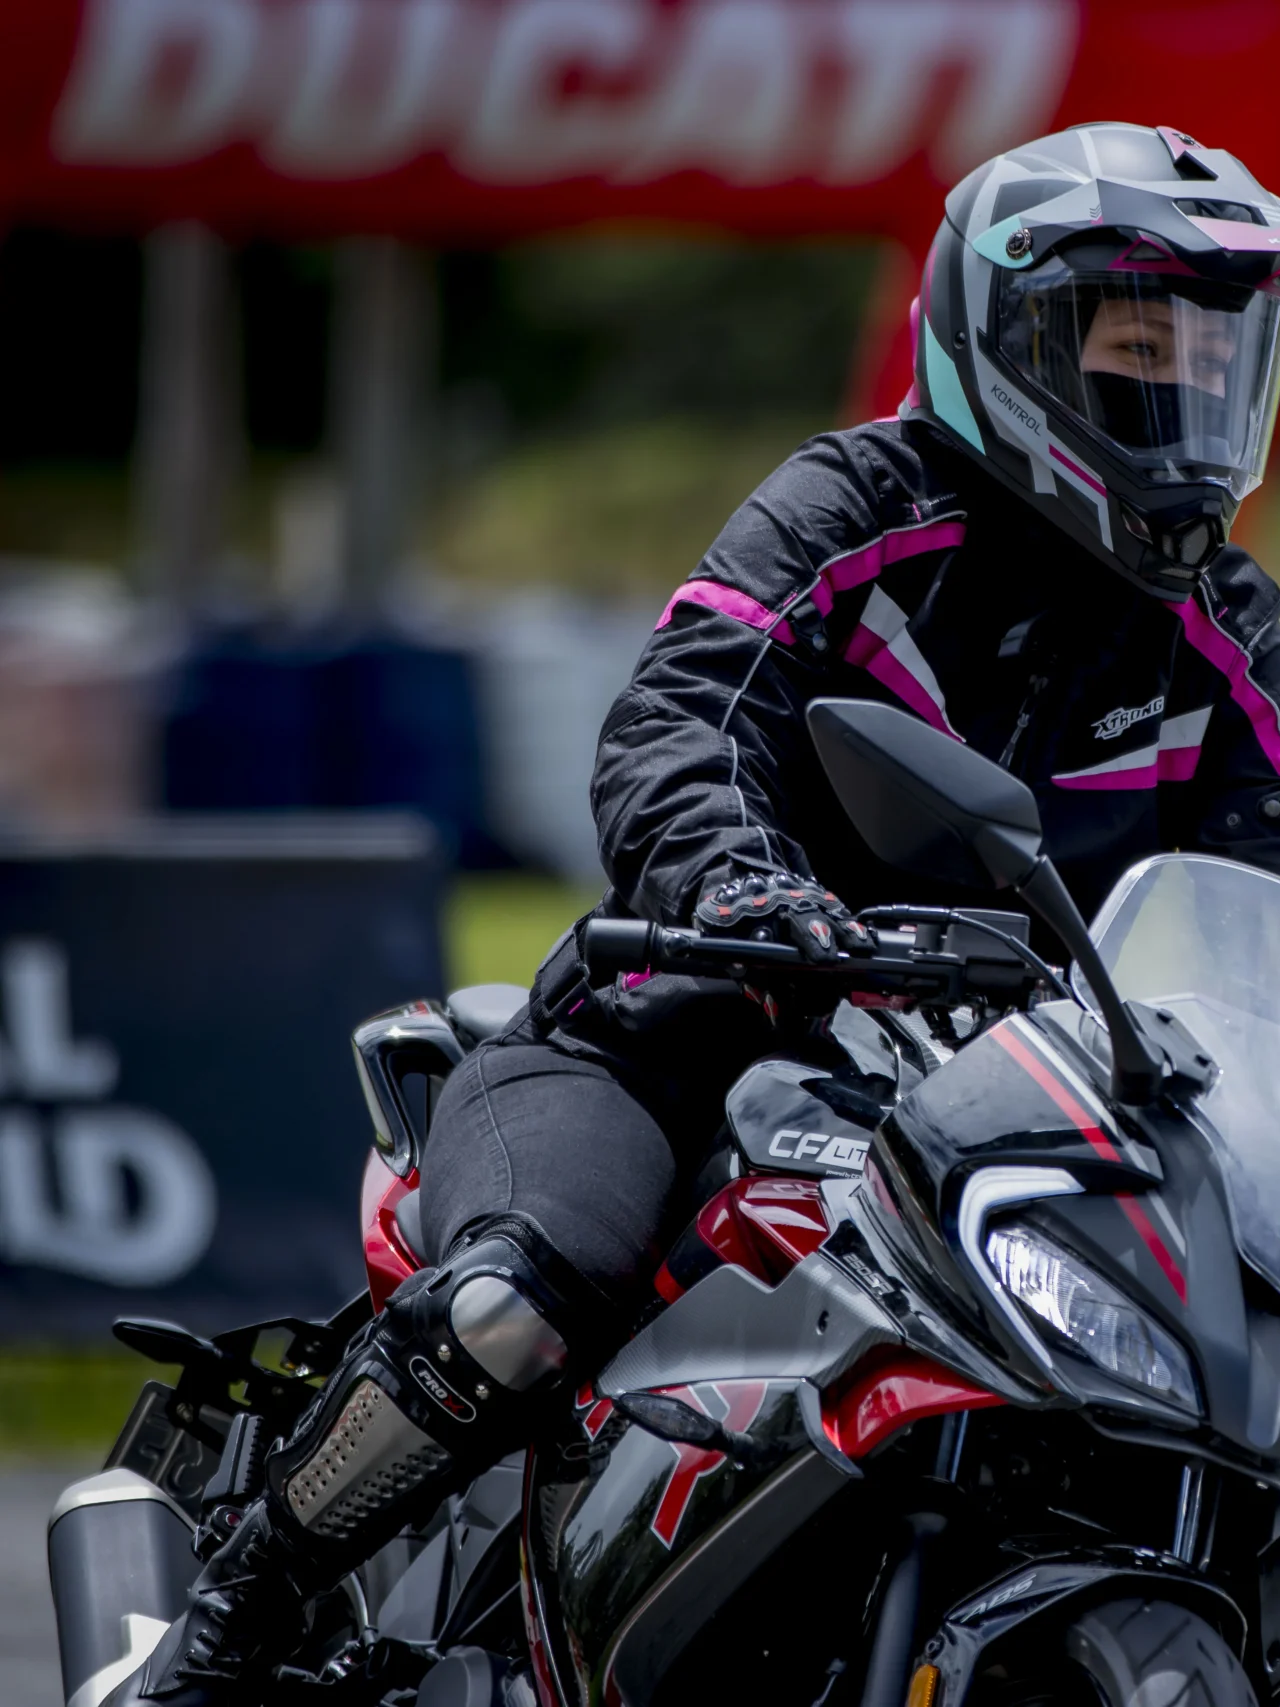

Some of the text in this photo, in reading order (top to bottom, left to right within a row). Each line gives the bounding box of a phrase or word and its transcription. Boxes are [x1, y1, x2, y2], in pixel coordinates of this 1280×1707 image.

[48, 0, 1082, 187] DUCATI
[990, 383, 1041, 437] KONTROL
[1097, 697, 1163, 734] XTRONG
[960, 1573, 1037, 1624] ABS
